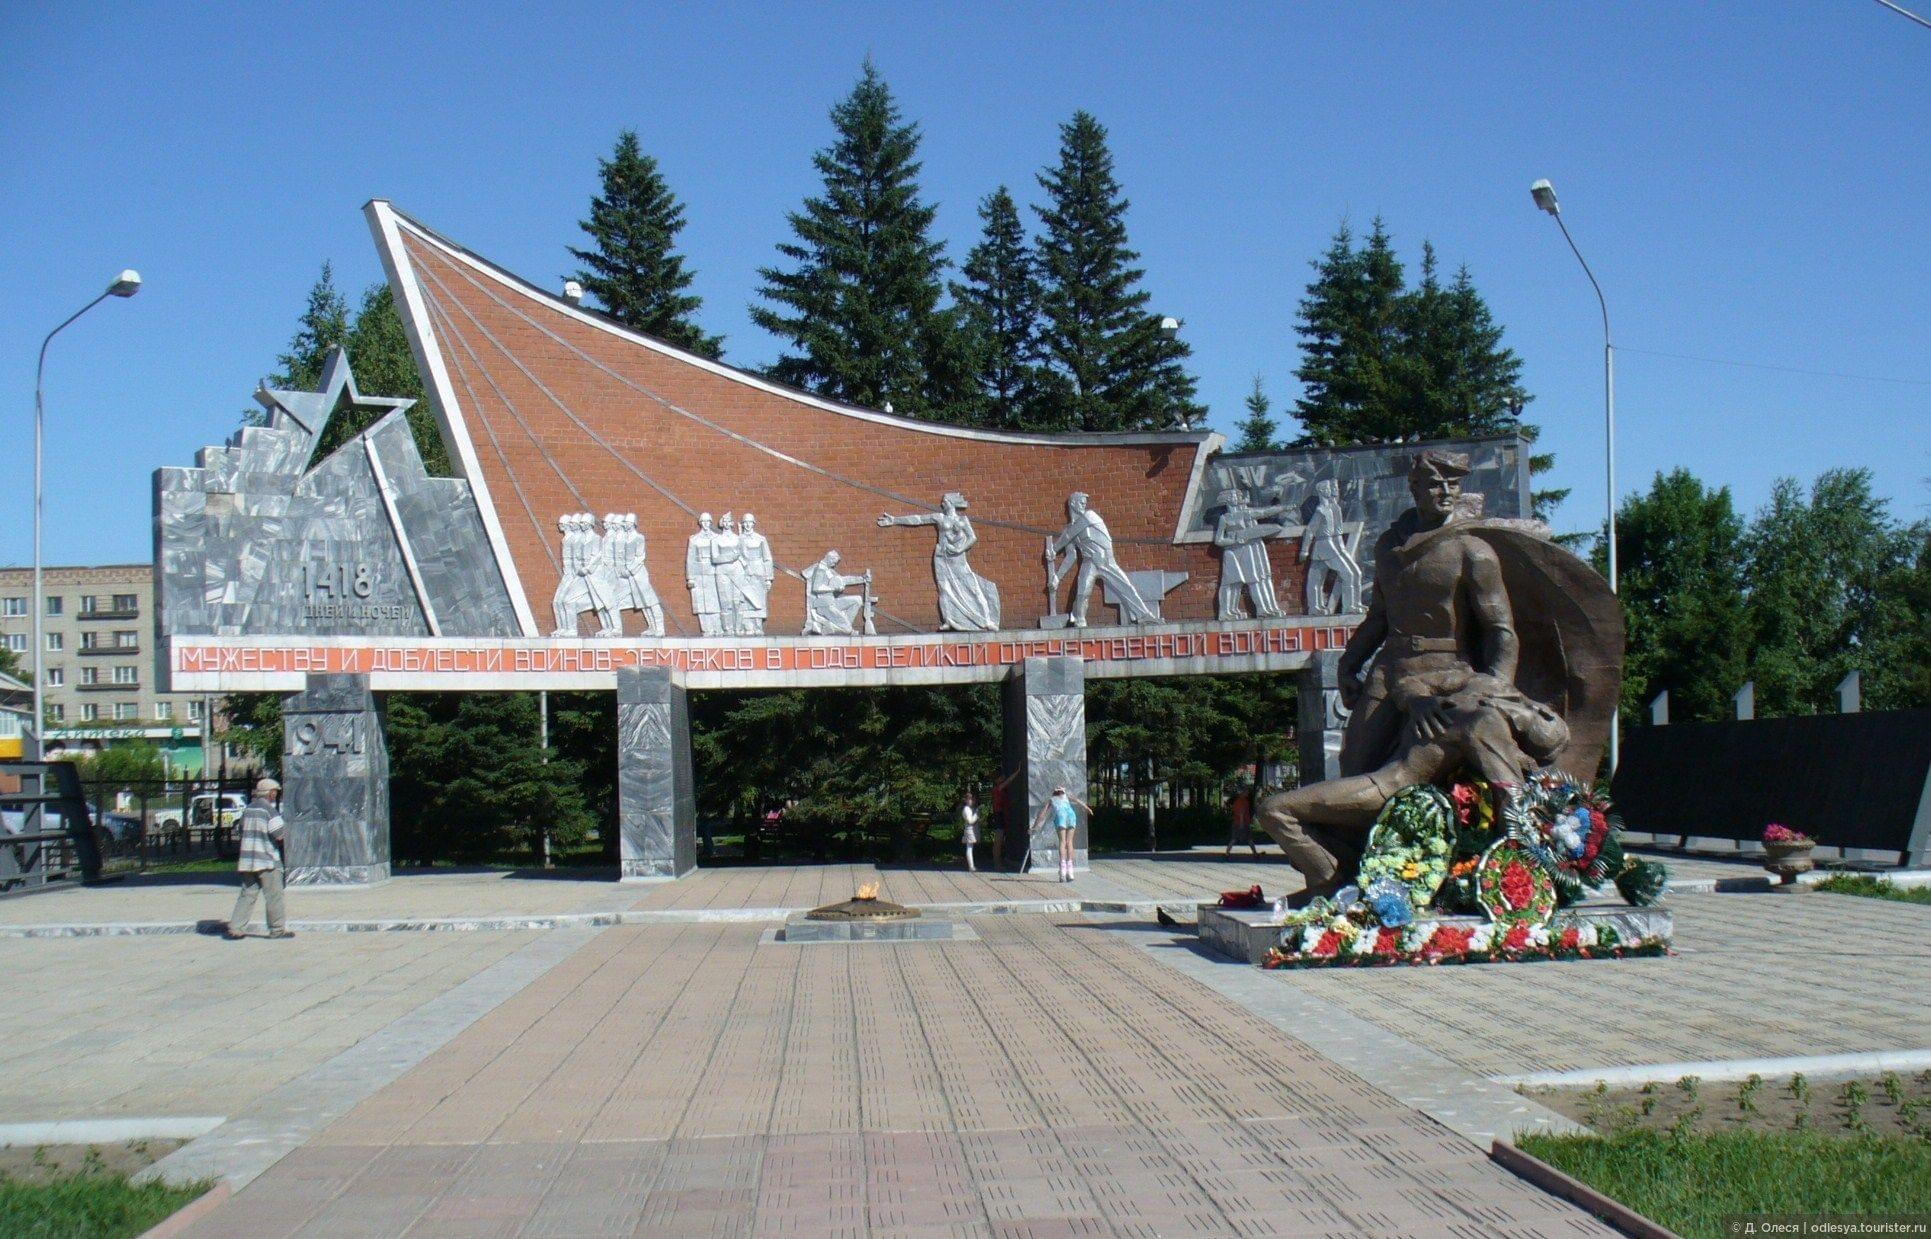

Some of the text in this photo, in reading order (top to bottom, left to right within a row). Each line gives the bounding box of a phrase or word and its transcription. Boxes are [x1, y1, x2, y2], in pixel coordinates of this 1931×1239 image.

[302, 562, 373, 598] 1418
[181, 648, 329, 672] МУЖЕСТВУ
[341, 648, 360, 672] И
[371, 648, 503, 672] ДОБЛЕСТИ
[766, 648, 782, 670] В
[795, 647, 863, 670] ГОДЫ
[875, 642, 988, 668] ВЕЛИКОЙ
[1219, 628, 1303, 654] ВОЙНЫ
[1314, 625, 1358, 650] ПО
